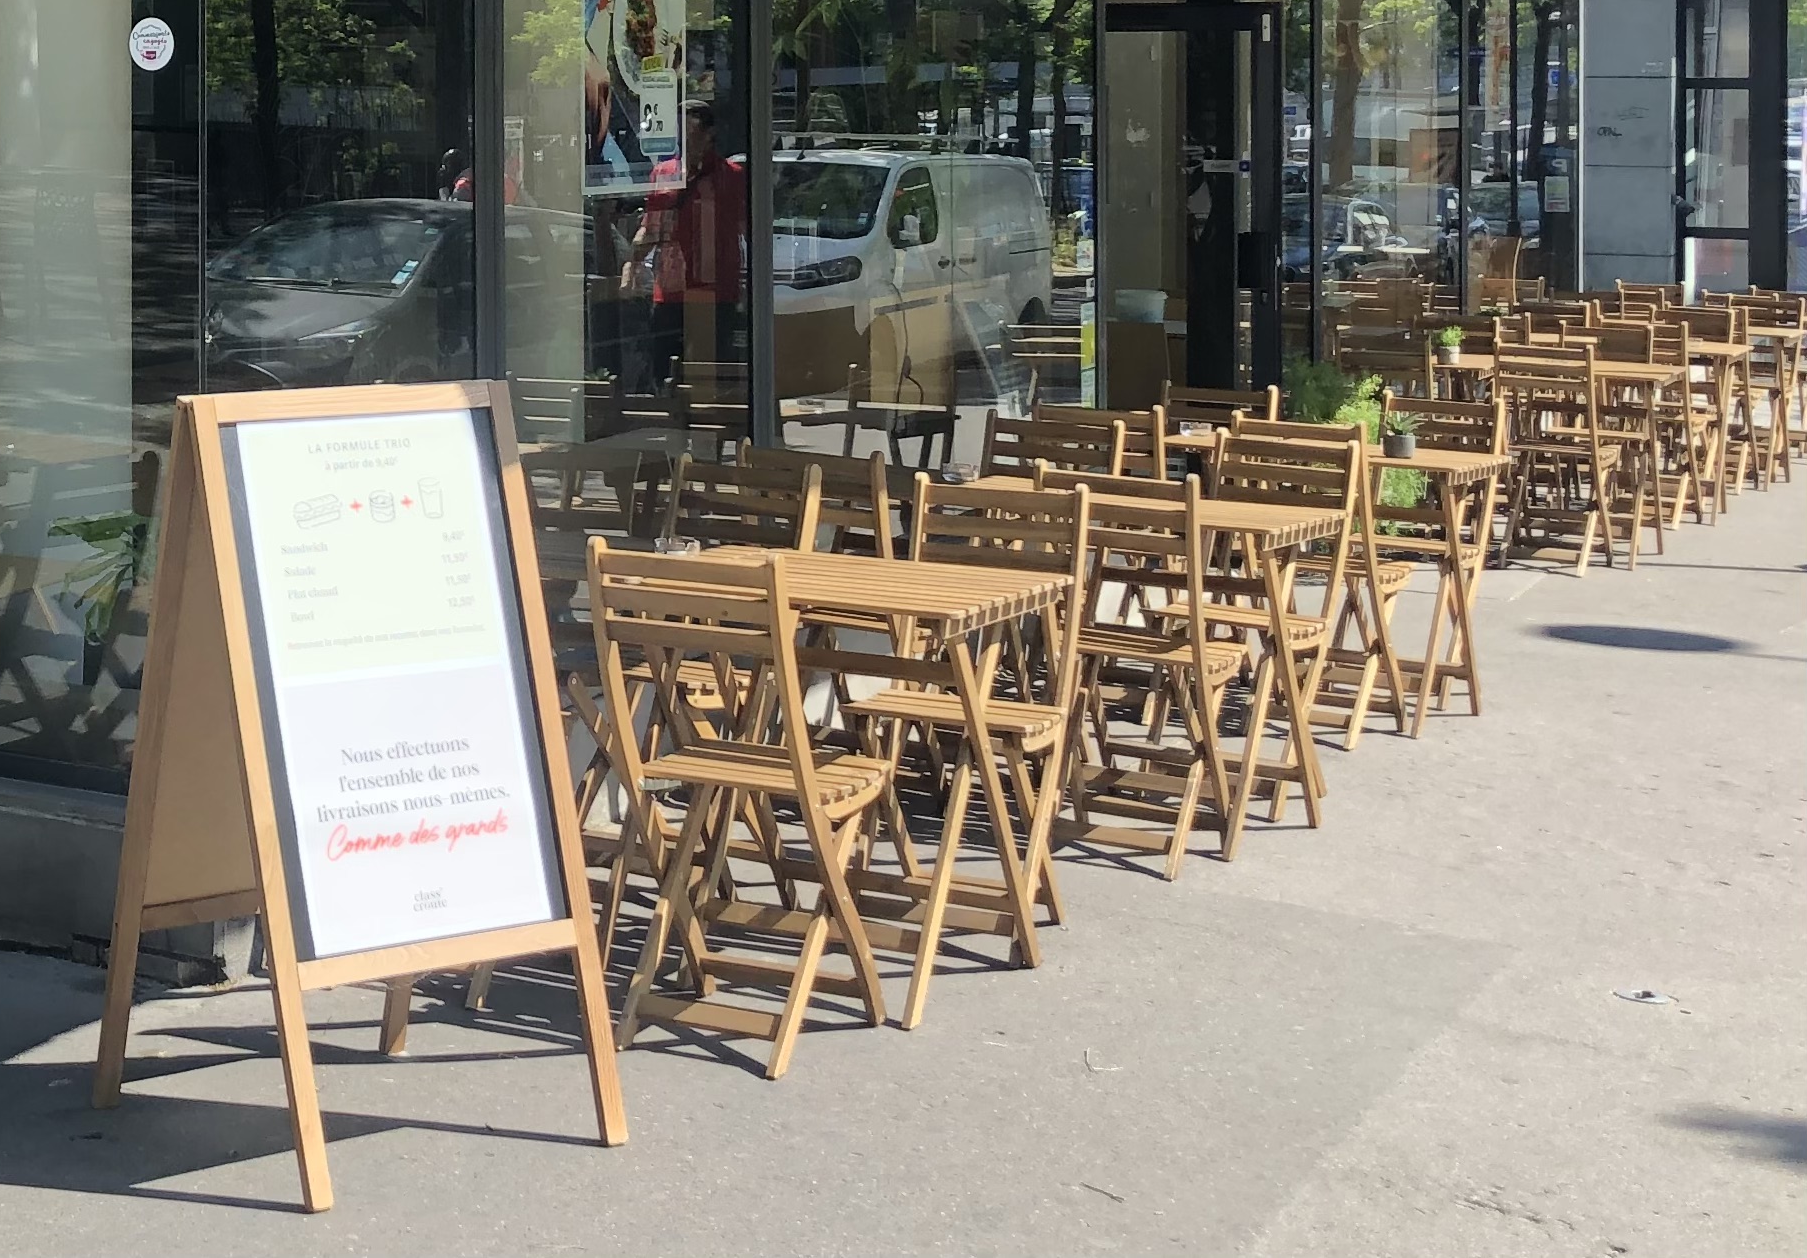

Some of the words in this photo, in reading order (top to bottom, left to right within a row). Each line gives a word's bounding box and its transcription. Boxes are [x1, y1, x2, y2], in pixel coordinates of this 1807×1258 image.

[308, 443, 322, 454] LA
[327, 439, 380, 453] FORMULE
[385, 437, 411, 449] TRIO
[341, 748, 383, 766] Nous
[387, 737, 471, 760] effectuons
[338, 767, 424, 793] l'ensemble
[428, 765, 446, 782] de
[452, 763, 481, 778] nos
[316, 800, 399, 823] livraisons
[327, 824, 404, 861] Comme
[409, 818, 441, 844] des
[445, 807, 509, 852] grands
